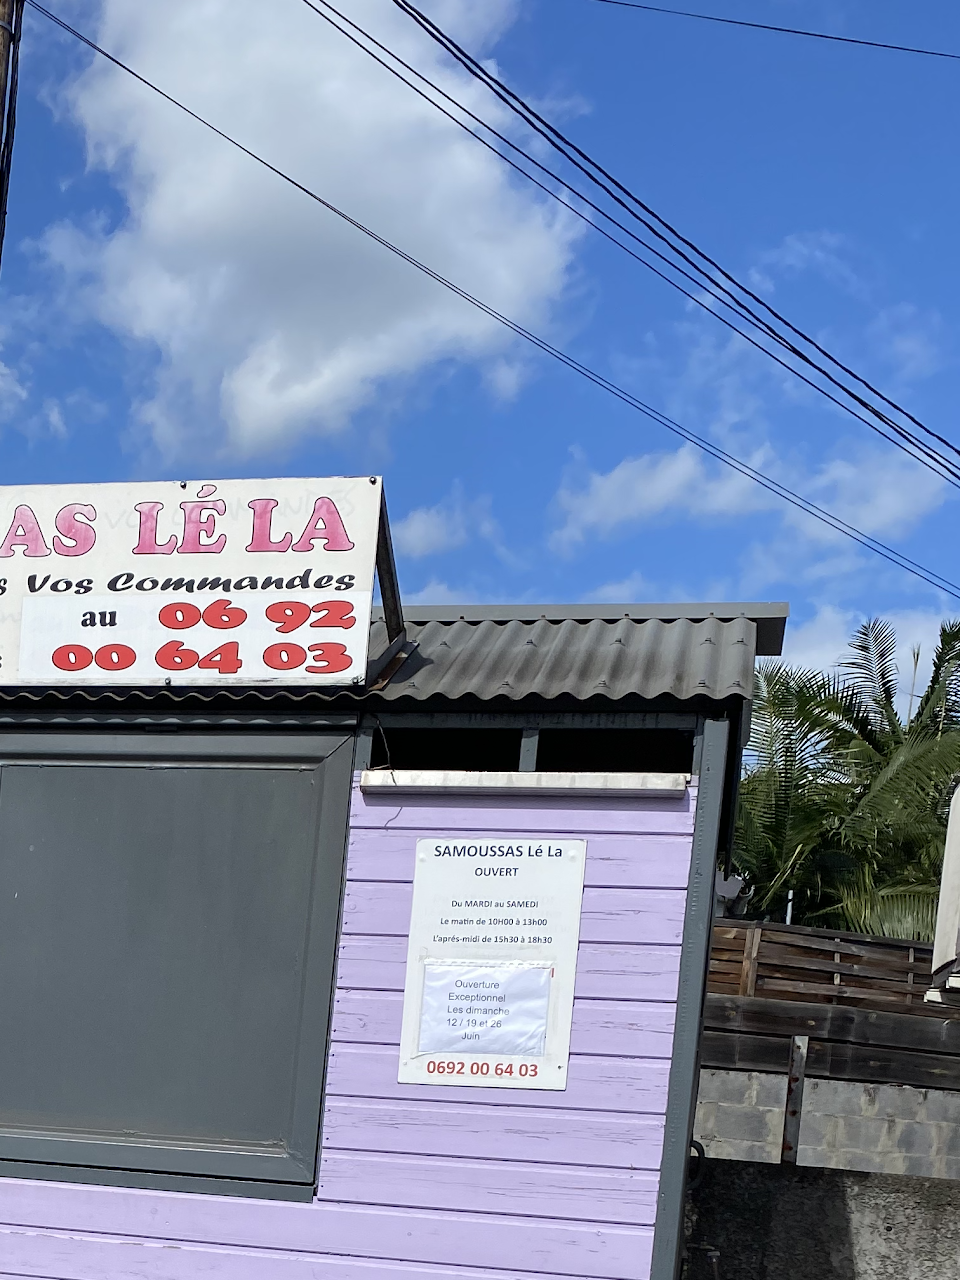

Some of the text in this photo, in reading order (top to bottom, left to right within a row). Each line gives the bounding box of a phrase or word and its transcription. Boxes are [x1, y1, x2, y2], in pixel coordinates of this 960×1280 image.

[132, 484, 227, 554] LÉ
[245, 497, 355, 552] LA
[27, 569, 355, 594] Vos Commandes
[81, 599, 356, 633] au 06 92
[52, 640, 353, 674] 00 64 03
[434, 844, 563, 858] SAMOUSSAS Lé La
[474, 867, 519, 877] OUVERT
[451, 900, 463, 908] Du
[465, 900, 493, 908] MARDI
[440, 918, 548, 926] Le matin de 10H00 à 13h00
[482, 935, 492, 943] de
[520, 936, 525, 944] à
[527, 936, 552, 944] 18h30
[455, 980, 500, 989] Ouverture
[448, 993, 506, 1003] Exceptionnel
[448, 1006, 510, 1016] Les dimanche
[447, 1019, 457, 1027] 12
[467, 1019, 477, 1027] 19
[479, 1019, 488, 1028] et
[490, 1020, 502, 1028] 26
[461, 1031, 480, 1040] Juin
[426, 1061, 538, 1077] 0692 00 64 03
